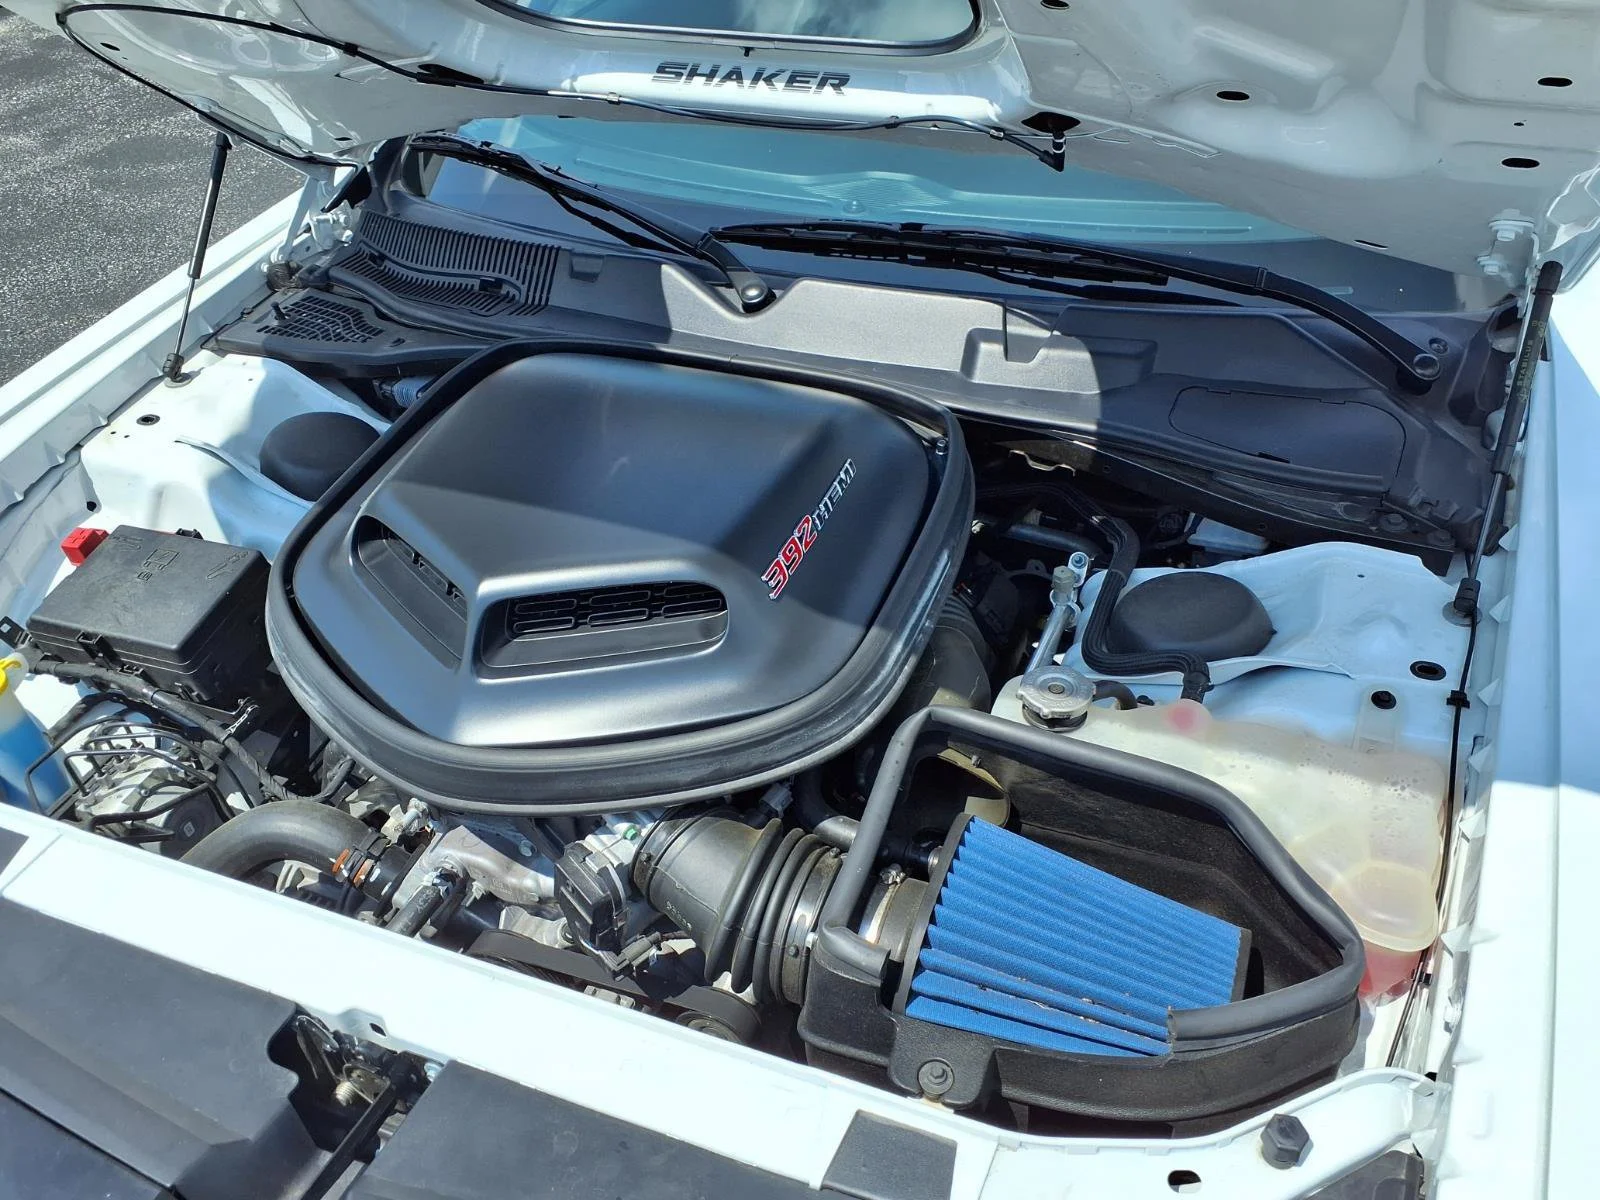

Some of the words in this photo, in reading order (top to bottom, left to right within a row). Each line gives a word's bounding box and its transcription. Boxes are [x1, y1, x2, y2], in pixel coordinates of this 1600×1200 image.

[652, 61, 850, 96] SHAKER
[761, 514, 818, 600] 392
[812, 458, 857, 531] HEMI
